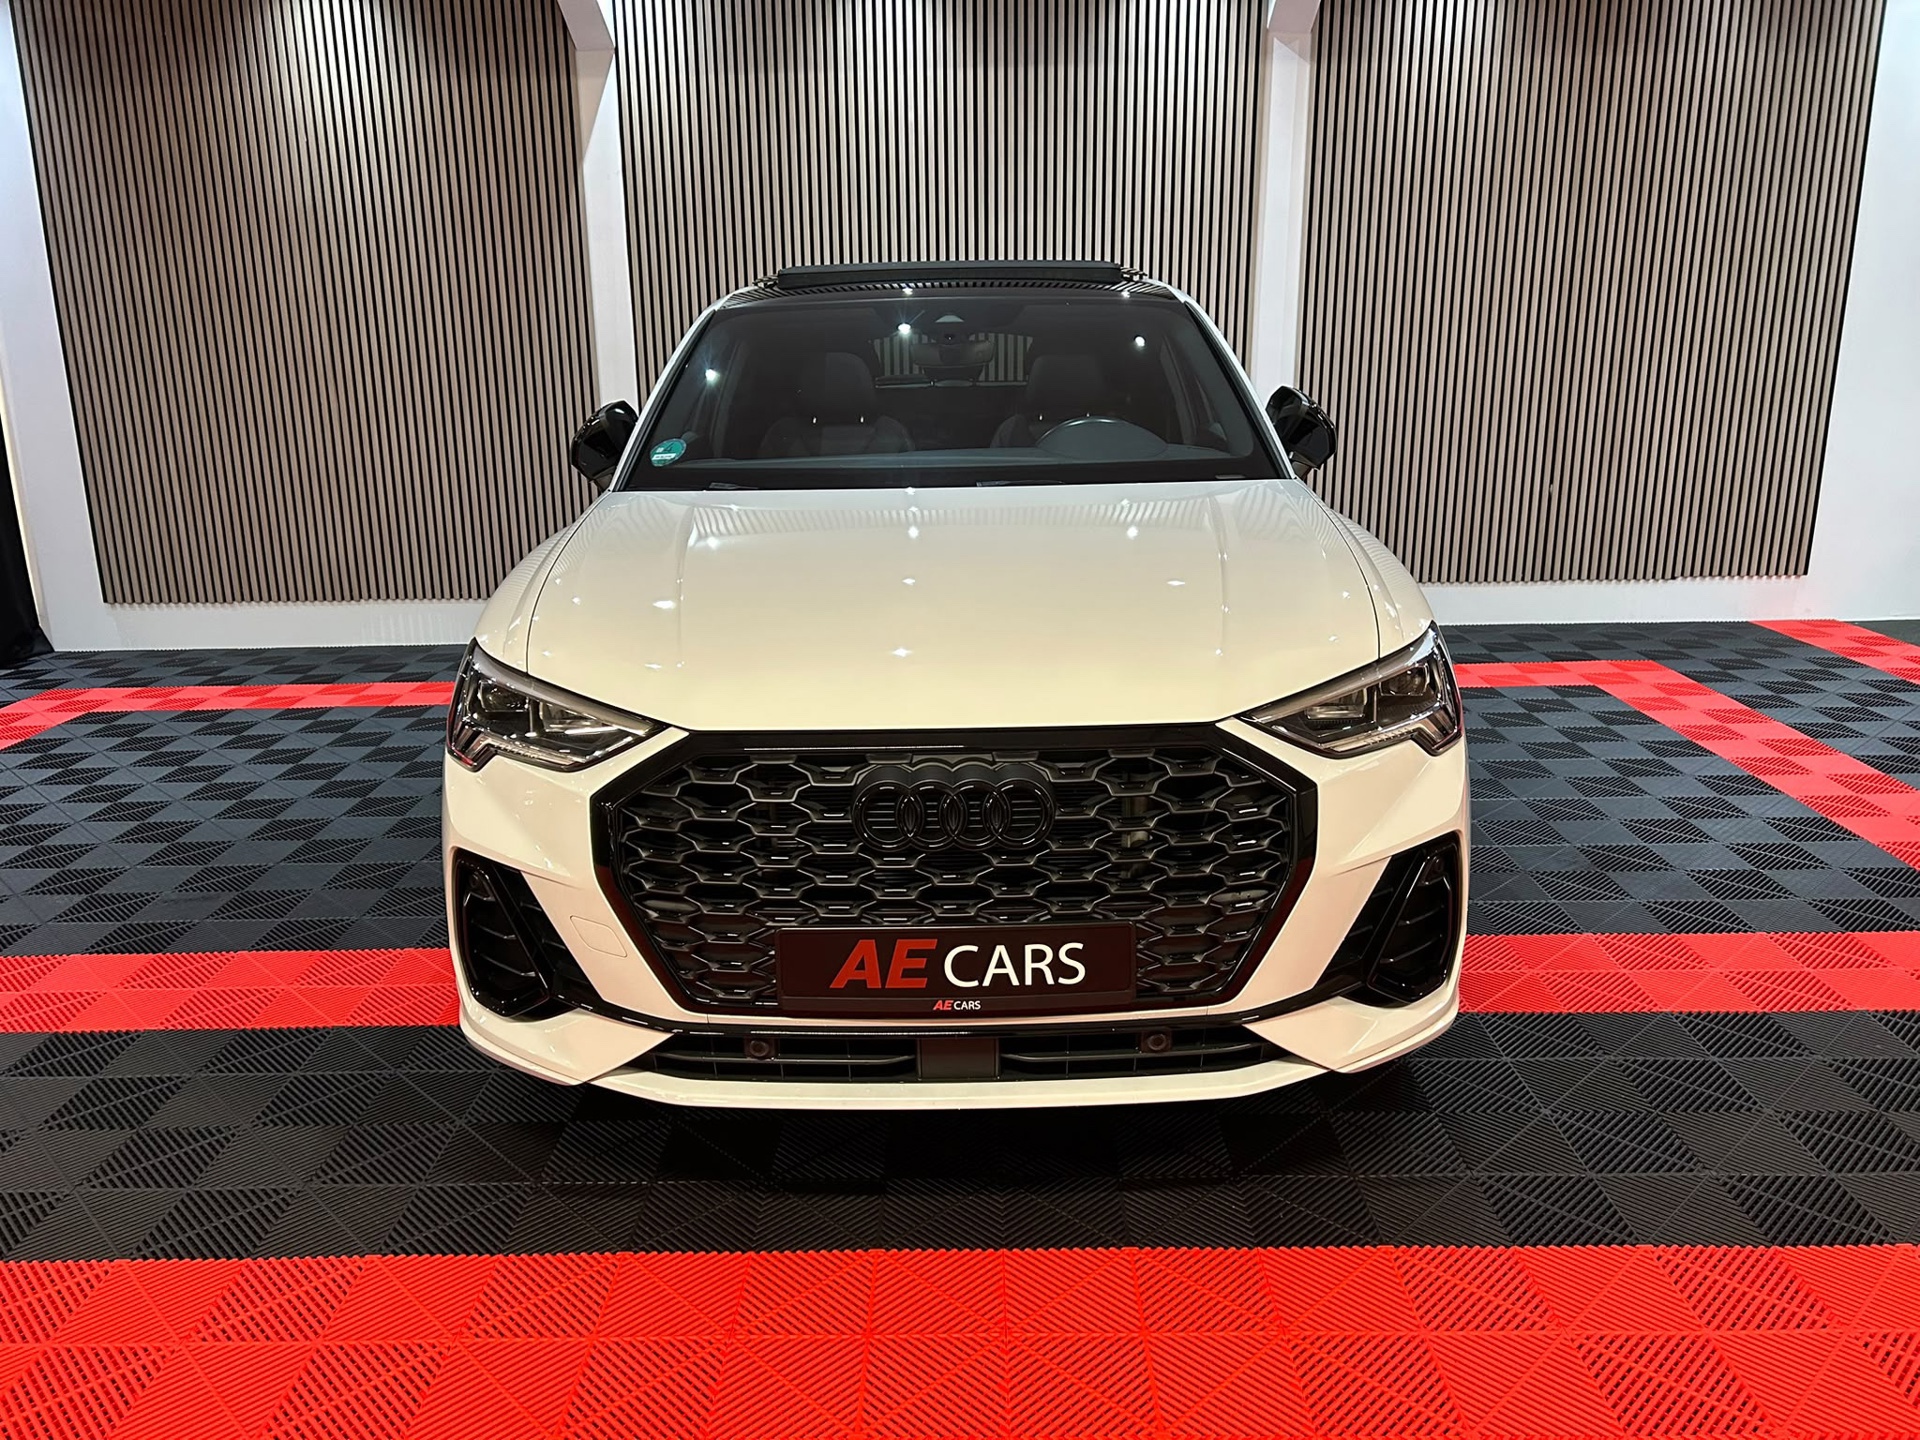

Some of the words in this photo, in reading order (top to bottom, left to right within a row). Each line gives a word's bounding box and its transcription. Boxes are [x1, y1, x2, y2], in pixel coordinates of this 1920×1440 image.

[829, 939, 938, 989] AE
[944, 942, 1086, 987] CARS
[933, 1000, 953, 1010] AE
[954, 1000, 981, 1010] CARS
